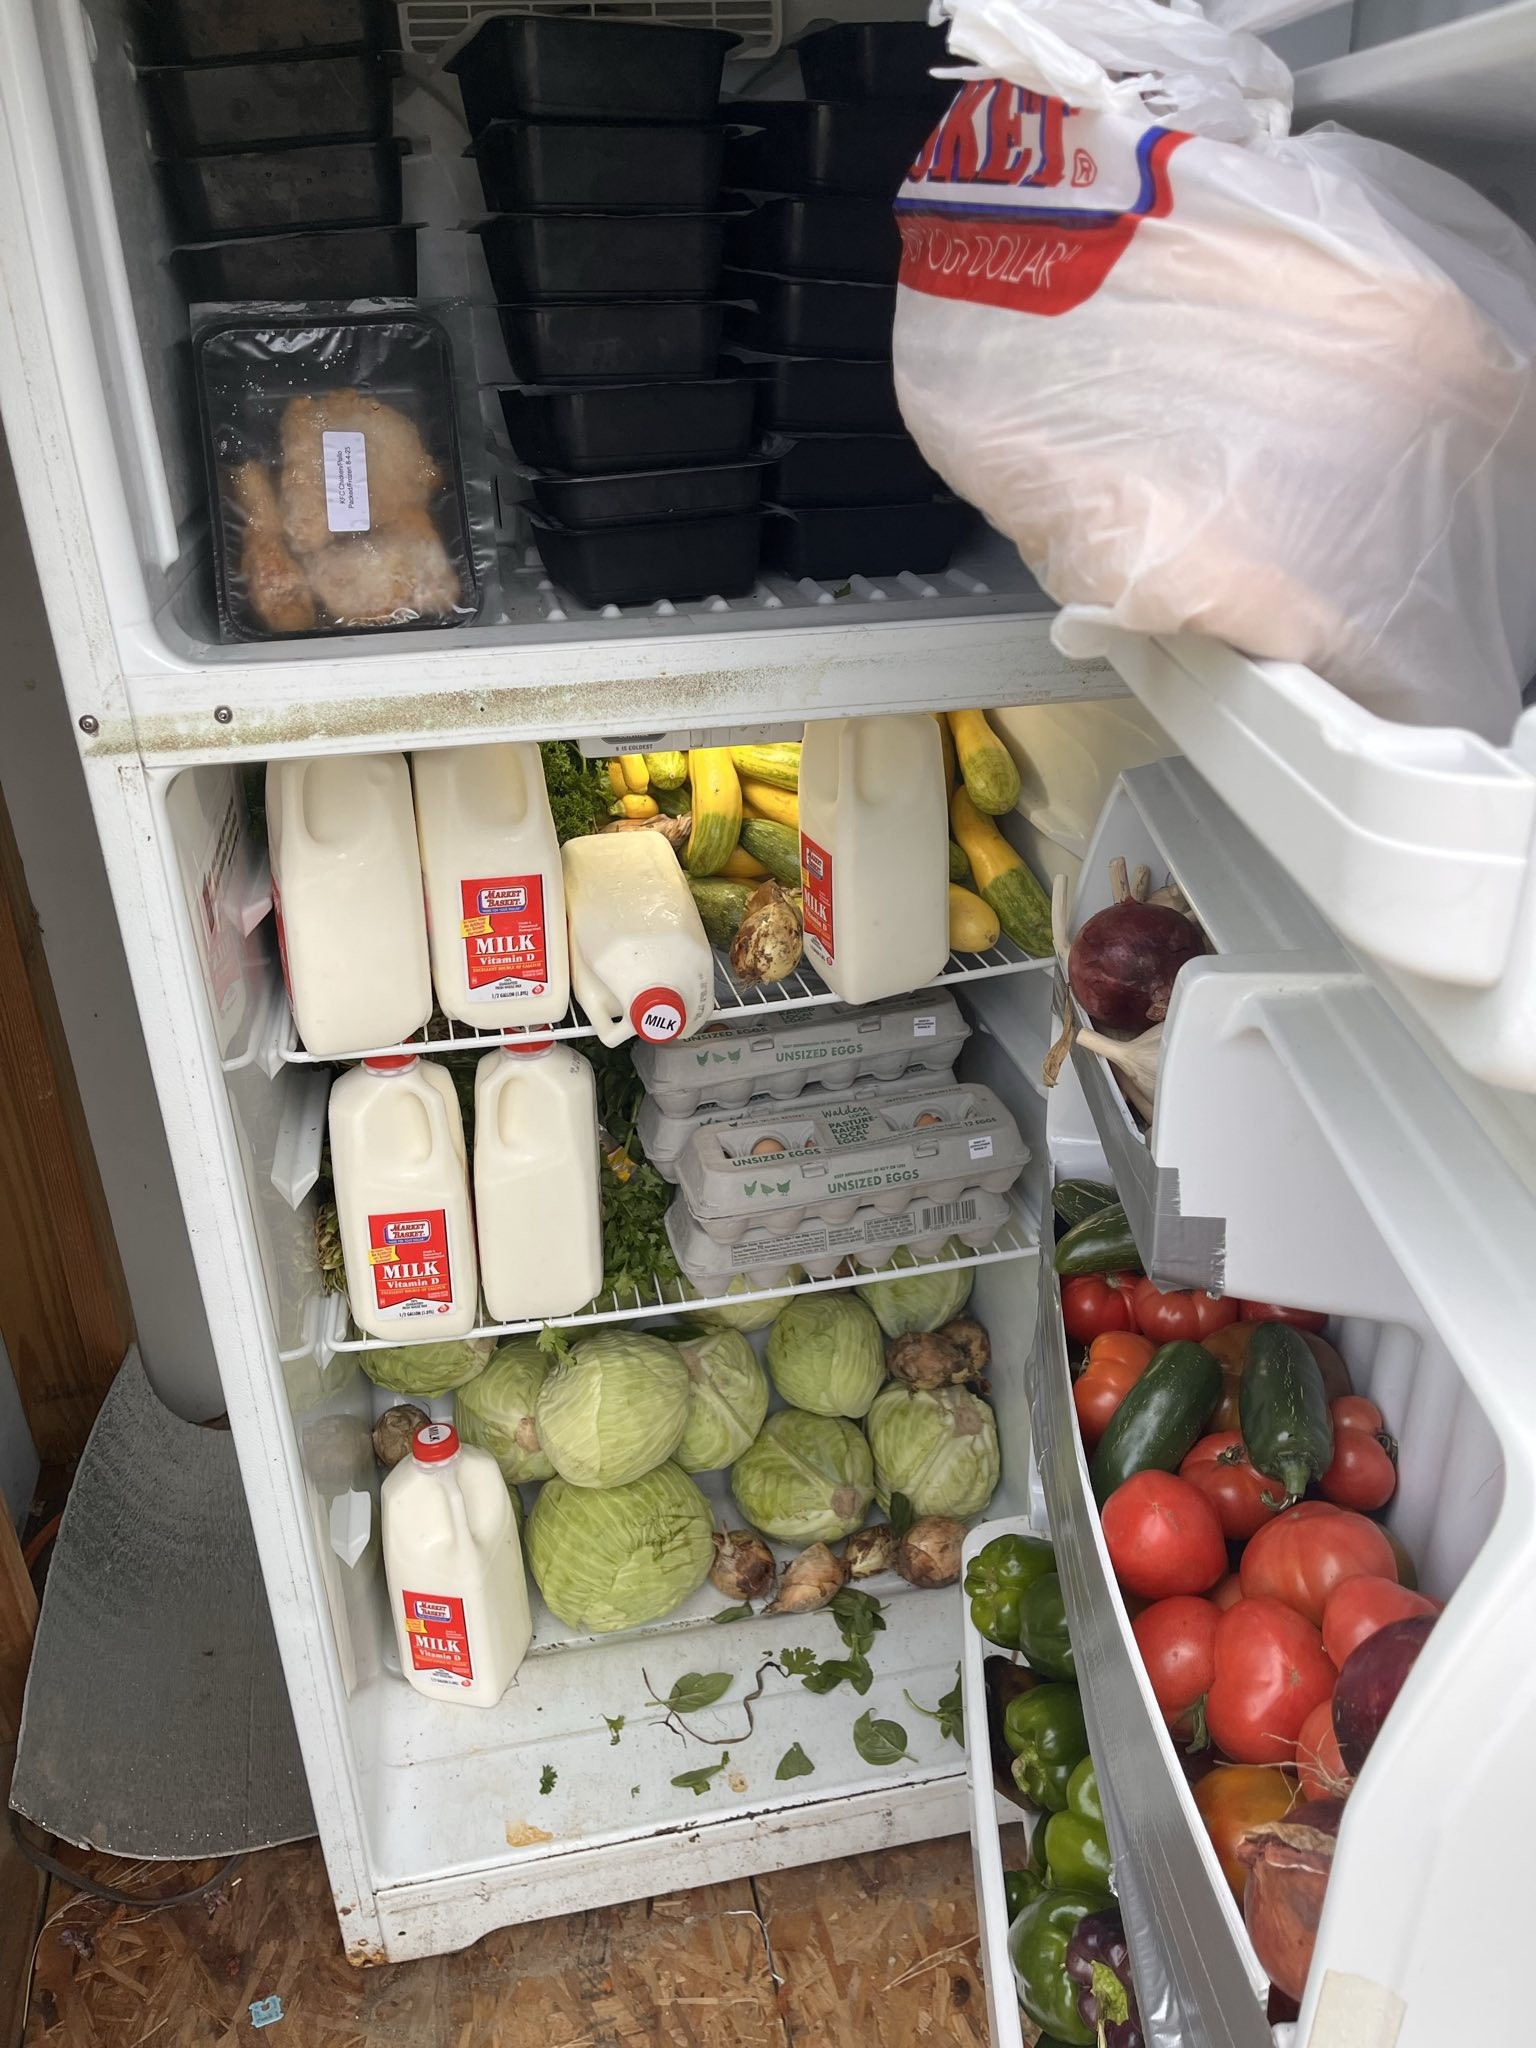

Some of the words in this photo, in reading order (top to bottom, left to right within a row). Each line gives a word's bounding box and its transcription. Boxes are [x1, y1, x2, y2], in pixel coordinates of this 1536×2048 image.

[628, 743, 653, 751] COLDEST
[484, 890, 522, 900] MARKET
[475, 934, 535, 955] MILK
[479, 954, 523, 966] Vitamin
[526, 953, 535, 962] D
[644, 1014, 678, 1032] MILK
[776, 1046, 827, 1063] UNSIZED
[831, 1043, 864, 1057] EGGS
[831, 1123, 870, 1135] RAISED
[963, 1120, 973, 1128] 12
[833, 1129, 870, 1140] LOCAL
[837, 1135, 867, 1145] EGGS
[732, 1152, 785, 1167] UNSIZED
[788, 1148, 822, 1158] EGGS
[827, 1175, 882, 1194] UNSIZED
[885, 1168, 920, 1184] EGGS
[390, 1223, 426, 1232] MARKET
[382, 1261, 440, 1279] MILK
[386, 1279, 428, 1289] Vitamin
[431, 1277, 440, 1285] D
[415, 1634, 461, 1653] MILK
[419, 1649, 452, 1660] Vitamin
